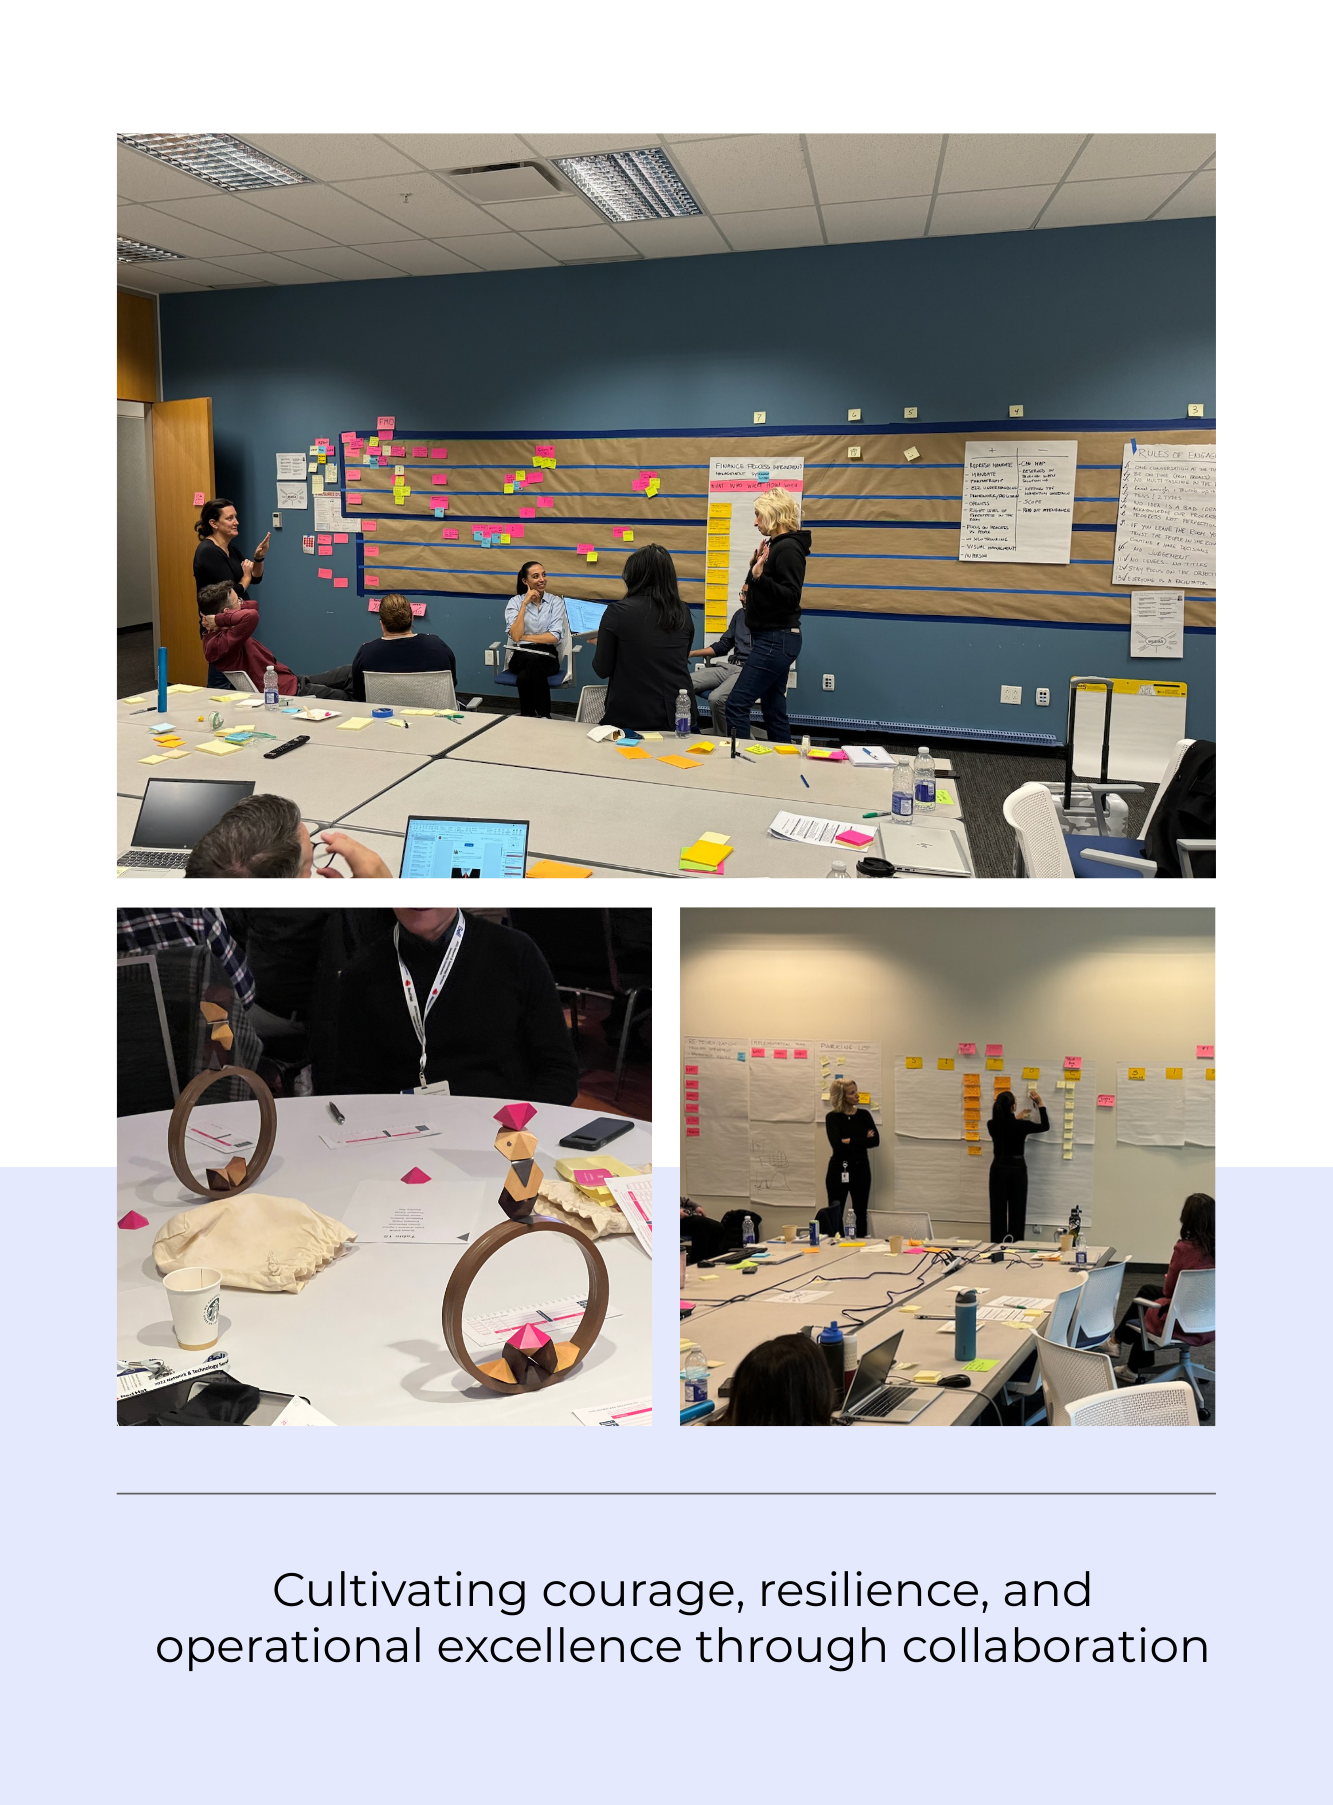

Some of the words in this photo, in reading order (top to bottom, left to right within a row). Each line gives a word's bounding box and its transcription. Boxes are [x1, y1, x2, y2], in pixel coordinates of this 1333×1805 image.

[1192, 406, 1199, 414] 3
[379, 418, 395, 426] FMO
[1138, 448, 1169, 458] RULES
[1172, 451, 1183, 459] OF
[820, 1042, 853, 1050] PARKING
[166, 1371, 187, 1382] Network
[192, 1363, 219, 1375] Technology
